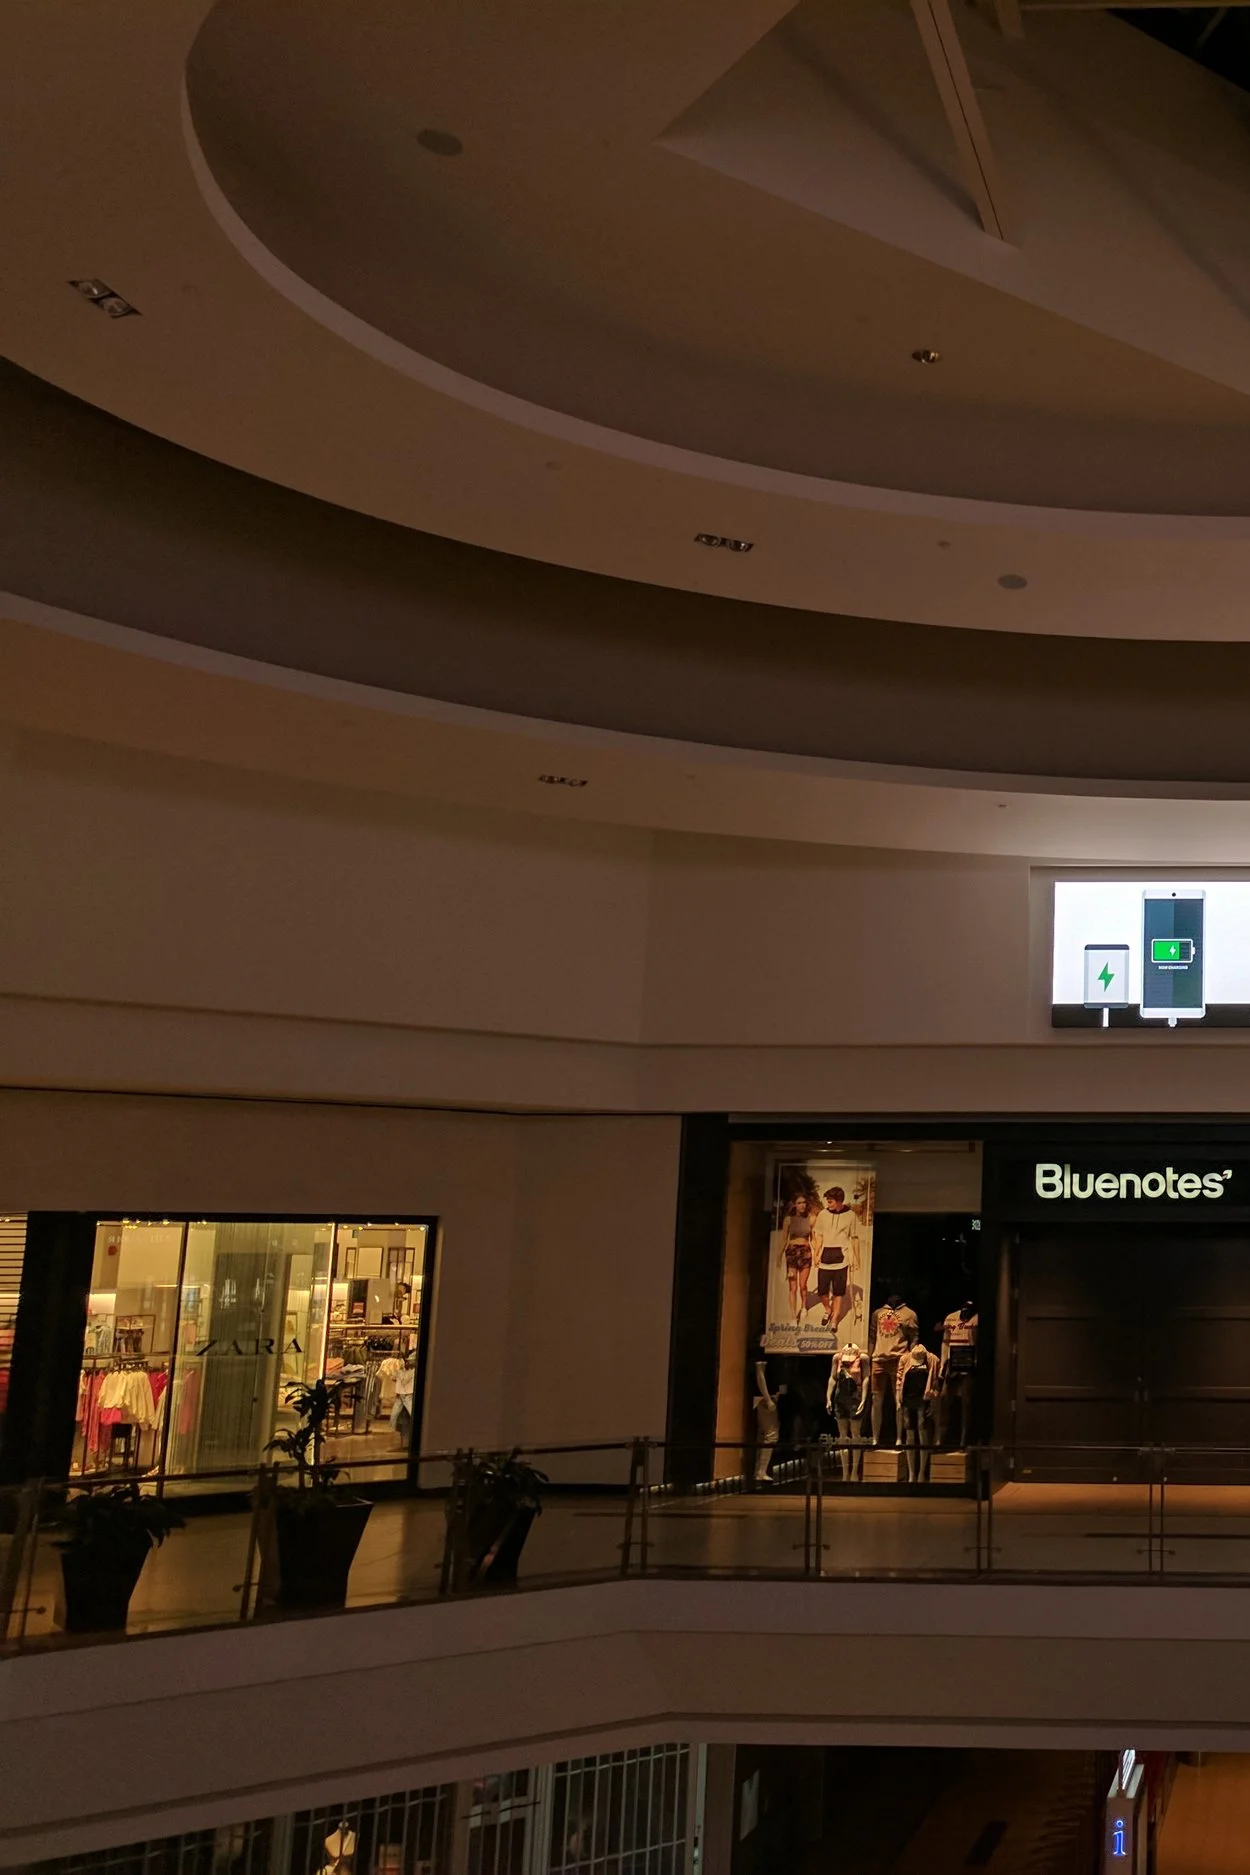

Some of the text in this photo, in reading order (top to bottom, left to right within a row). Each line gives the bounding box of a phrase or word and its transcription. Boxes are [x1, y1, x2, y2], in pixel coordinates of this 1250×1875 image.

[768, 1323, 833, 1336] Spring Break
[195, 1338, 304, 1356] ZARA
